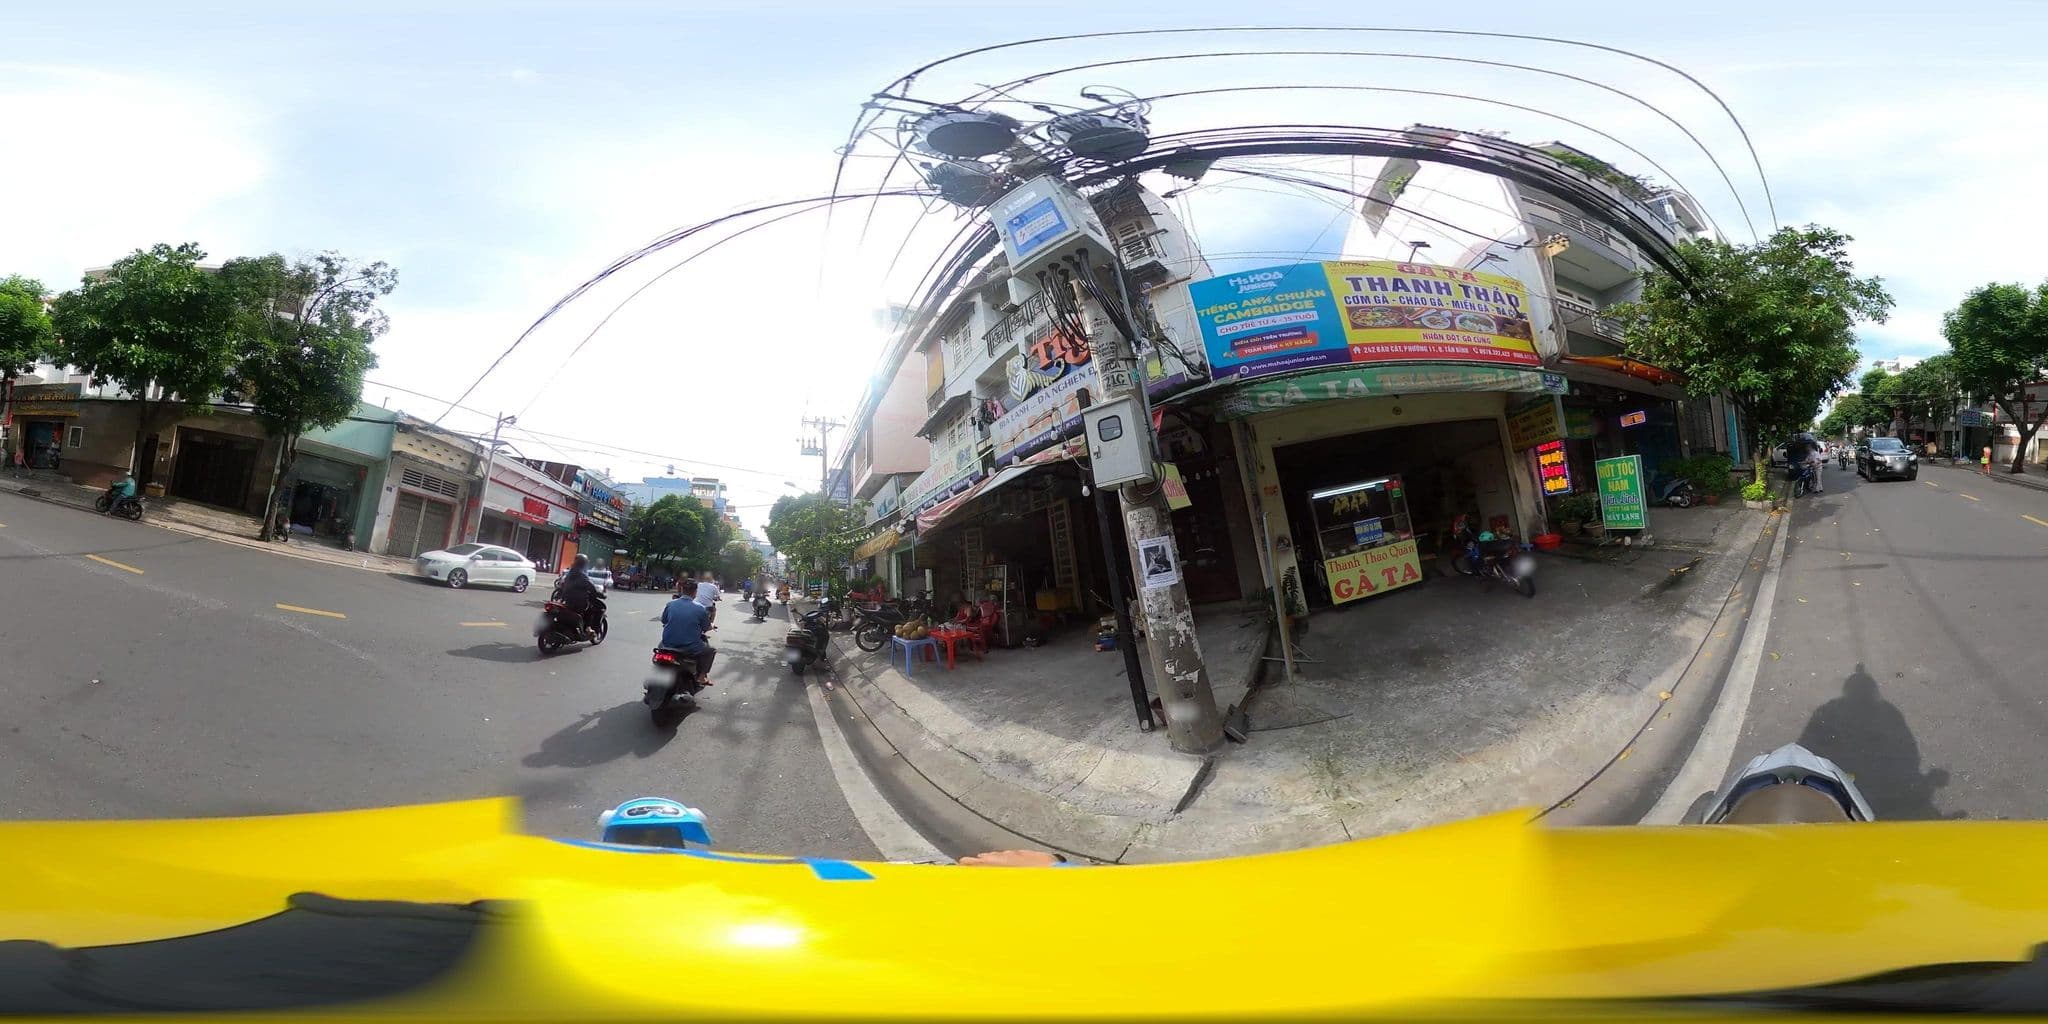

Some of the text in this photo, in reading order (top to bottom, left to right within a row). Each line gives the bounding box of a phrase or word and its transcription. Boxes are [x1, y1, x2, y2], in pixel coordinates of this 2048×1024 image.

[1345, 276, 1453, 297] THANH
[1241, 295, 1273, 309] ANH
[1344, 294, 1371, 306] CƠM
[1214, 300, 1315, 323] CAMBRIDGE
[1219, 325, 1239, 334] CHO
[1319, 377, 1371, 399] TA
[1616, 460, 1635, 479] TÓC
[1607, 479, 1630, 492] NAM
[1327, 555, 1361, 574] Thanh
[1334, 562, 1419, 600] GÀ TA
